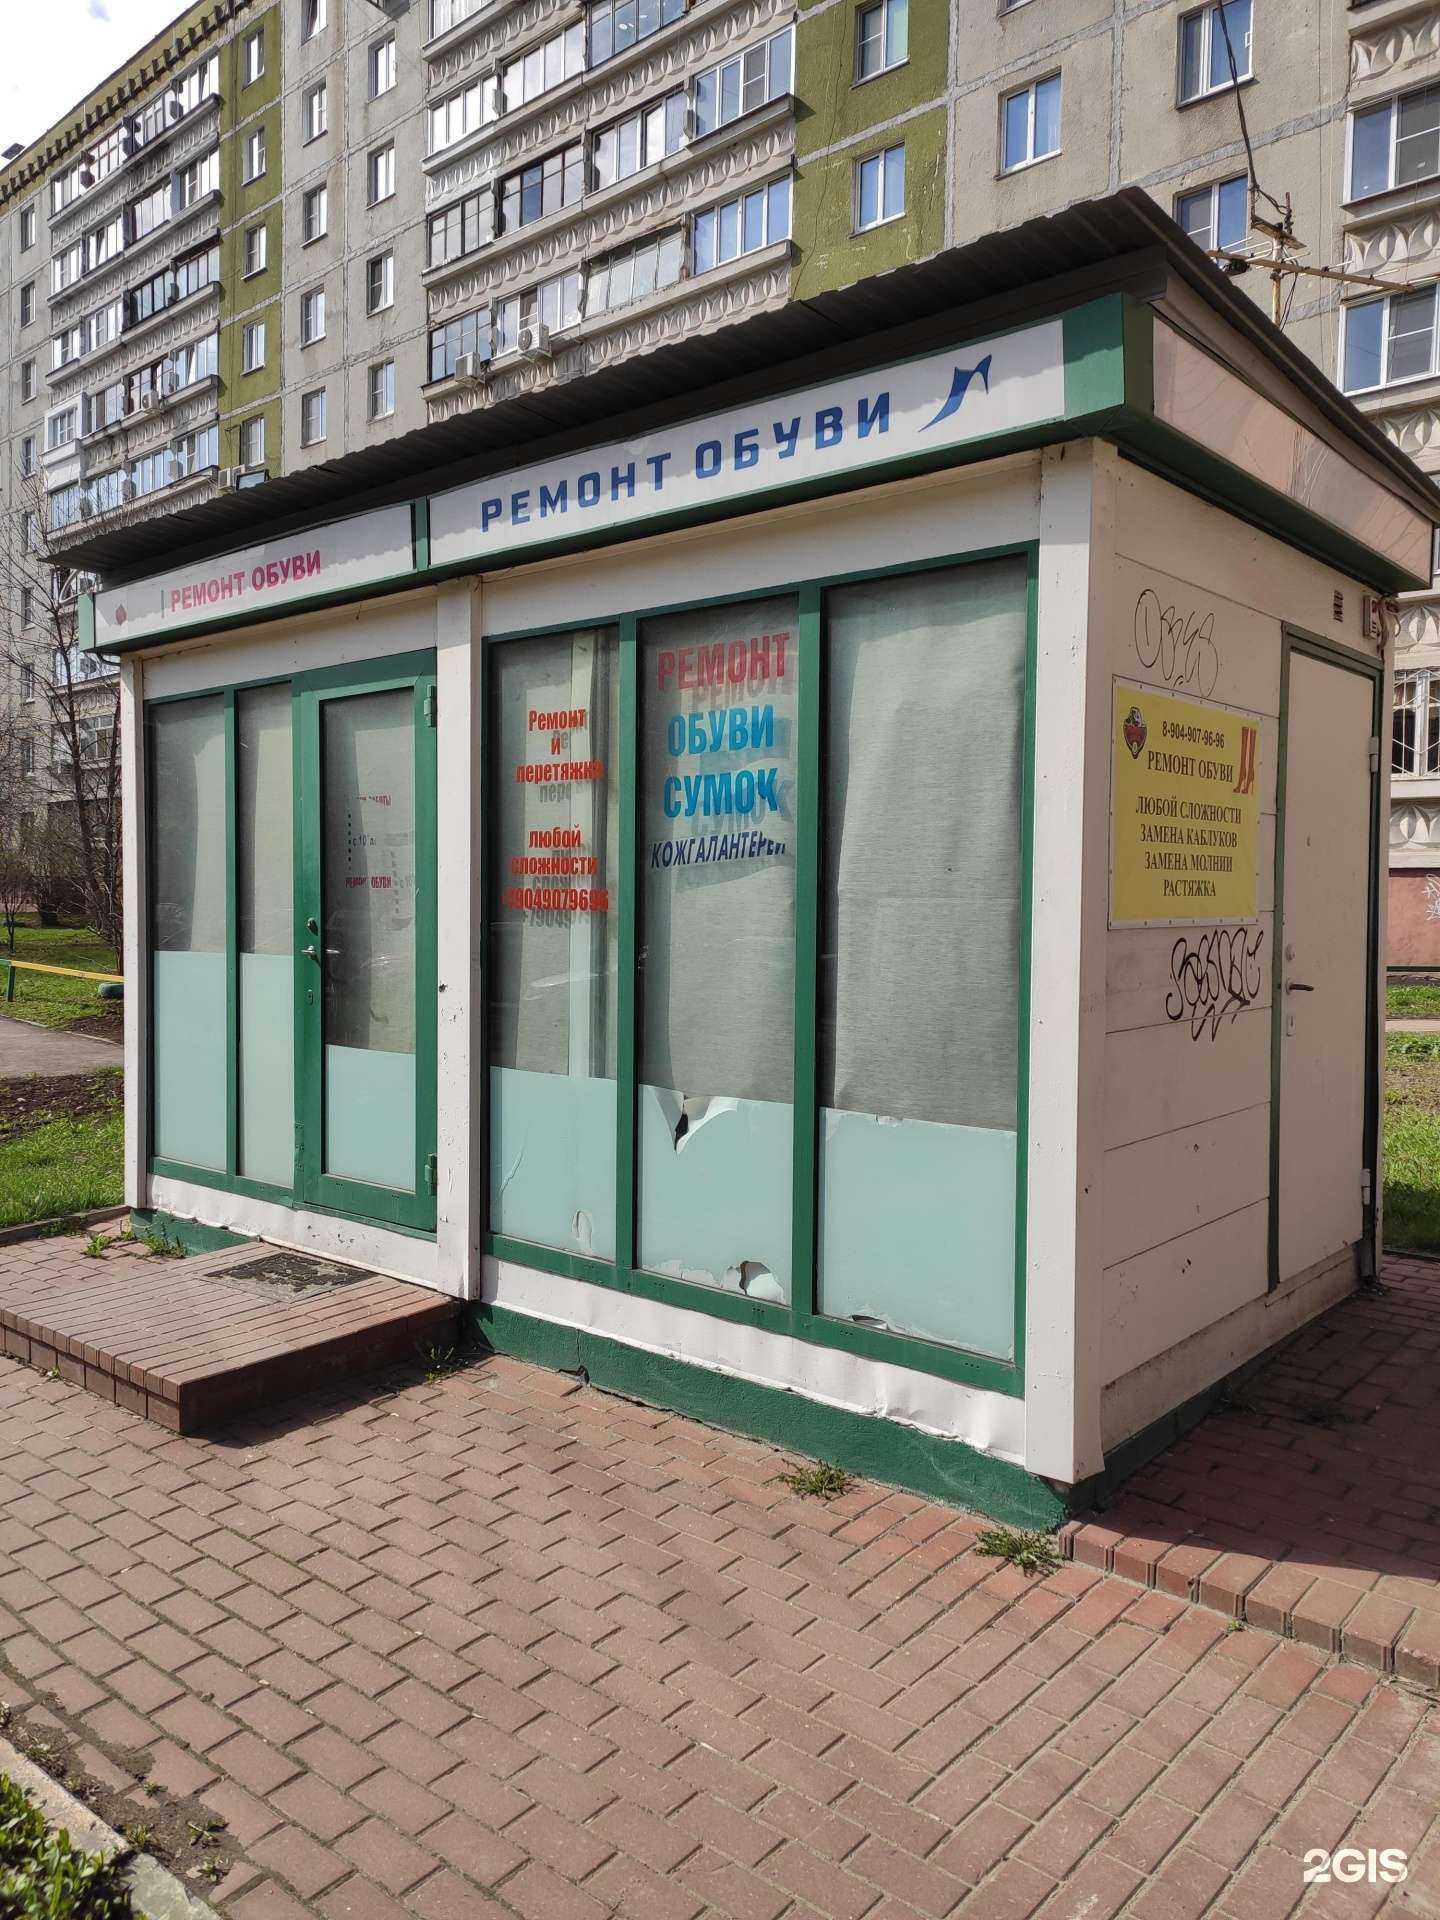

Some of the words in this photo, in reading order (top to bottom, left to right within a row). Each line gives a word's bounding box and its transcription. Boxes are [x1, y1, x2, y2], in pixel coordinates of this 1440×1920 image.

[481, 451, 672, 534] РЕМОНТ
[694, 391, 890, 480] ОБУВИ
[171, 571, 246, 613] РЕМОНТ
[251, 549, 321, 591] ОБУВИ
[657, 632, 789, 691] РЕМОНТ
[528, 708, 587, 732] Ремонт
[668, 704, 774, 757] ОБУВИ
[1162, 720, 1225, 749] 8-904-907-96-96
[1147, 750, 1197, 777] РЕМОНТ
[1198, 759, 1235, 783] ОБУВИ
[663, 768, 778, 818] СУМОК
[1135, 795, 1177, 817] ЛЮБОЙ
[1180, 801, 1242, 824] СЛОЖНОСТИ
[529, 823, 581, 848] любой
[1140, 823, 1184, 844] ЗАМЕНА
[1186, 828, 1238, 848] КАБЛУКОВ
[1144, 851, 1188, 871] ЗАМЕНА
[1190, 854, 1233, 872] МОЛНИИ
[1162, 879, 1216, 897] РАСТЯЖКА
